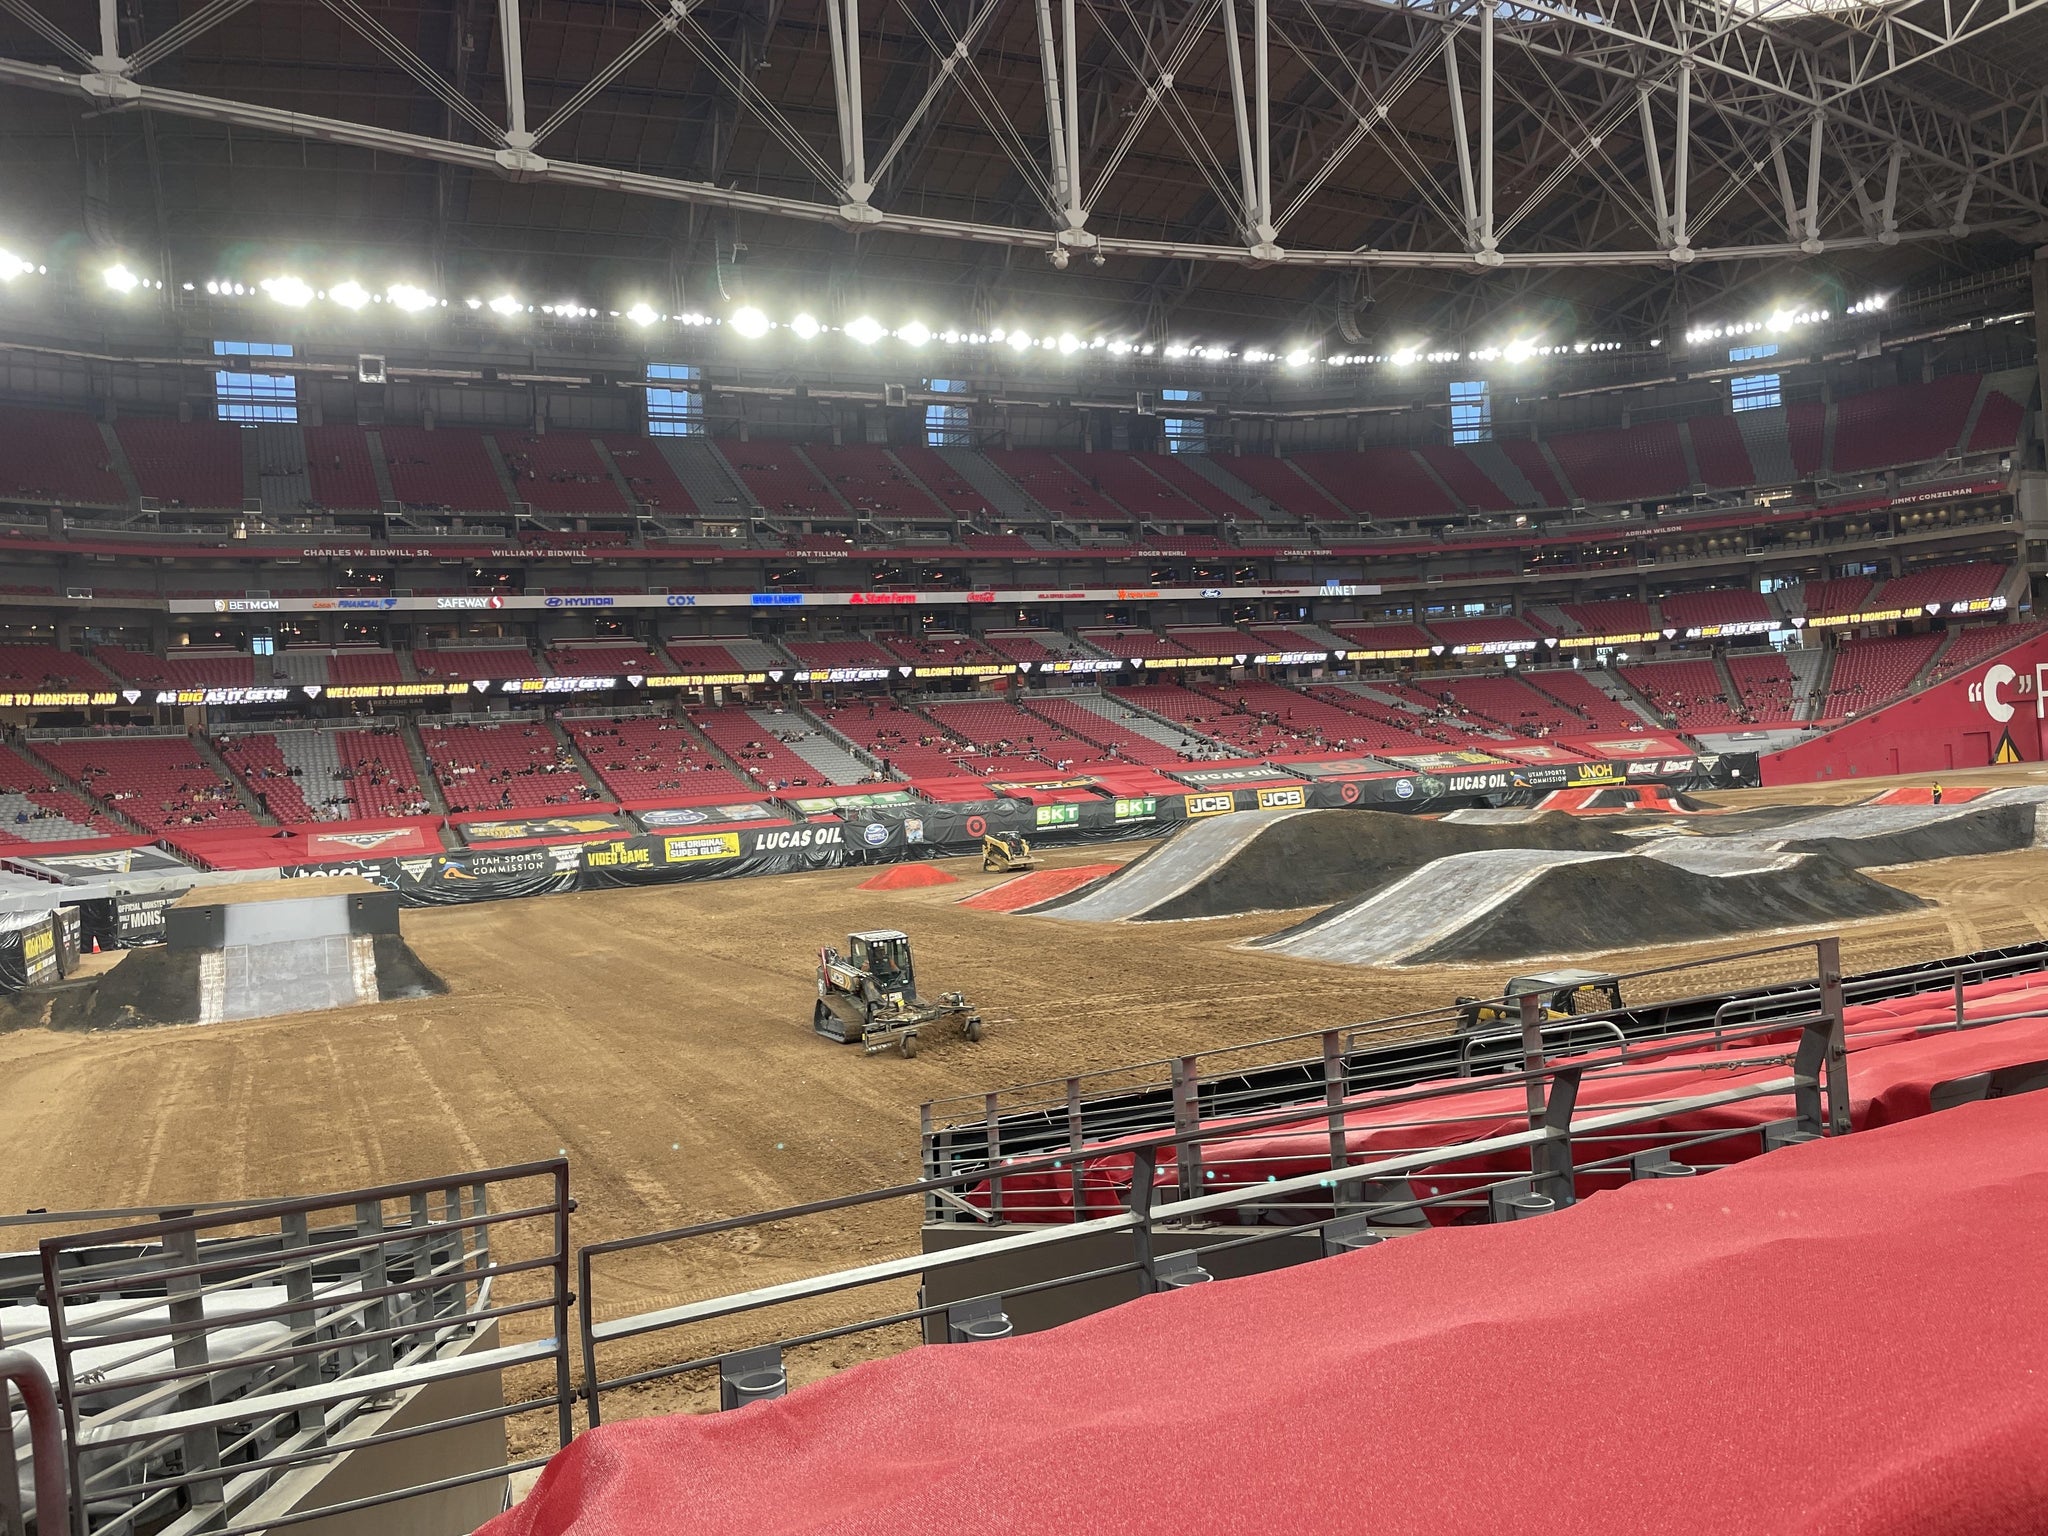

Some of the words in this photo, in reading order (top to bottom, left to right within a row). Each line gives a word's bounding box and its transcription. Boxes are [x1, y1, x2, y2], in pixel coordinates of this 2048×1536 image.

[1890, 495, 1917, 506] JIMMY
[1919, 487, 1973, 501] CONZELMAN
[1625, 529, 1652, 537] ADRIAN
[1653, 525, 1682, 534] WILSON
[303, 549, 351, 557] CHARLES
[354, 549, 368, 557] W.
[370, 549, 414, 558] BIDWILL,
[417, 549, 433, 557] SR.
[1319, 585, 1357, 596] AVNET
[230, 600, 279, 610] BETMGM
[338, 600, 379, 608] FINANCIAL
[437, 597, 488, 608] SAFEWAY
[565, 597, 614, 606] HYUNDAI
[667, 595, 696, 605] COX
[866, 593, 890, 604] State
[891, 593, 916, 604] Farm
[1951, 603, 1968, 613] AS
[1969, 600, 1989, 610] BIG
[1989, 597, 2006, 607] AS
[1808, 616, 1849, 627] WELCOME
[1850, 615, 1860, 624] TO
[1861, 611, 1902, 623] MONSTER
[1903, 608, 1923, 618] JAM
[1686, 628, 1701, 637] AS
[1702, 627, 1720, 636] BIG
[1720, 626, 1735, 635] AS
[1735, 625, 1747, 633] IT
[1559, 638, 1594, 648] WELCOME
[1594, 637, 1604, 646] TO
[1605, 635, 1640, 645] MONSTER
[1641, 632, 1660, 642] JAM
[1347, 651, 1376, 660] WELCOME
[1376, 650, 1384, 659] TO
[1385, 649, 1413, 659] MONSTER
[1414, 648, 1430, 657] JAM
[1452, 646, 1466, 654] AS
[1467, 645, 1482, 653] BIG
[1483, 644, 1496, 652] AS
[1496, 643, 1506, 652] IT
[1145, 660, 1177, 668] WELCOME
[1178, 659, 1186, 667] TO
[1186, 658, 1219, 667] MONSTER
[1219, 657, 1234, 665] JAM
[1254, 655, 1267, 663] AS
[1267, 654, 1281, 662] BIG
[1281, 654, 1294, 662] AS
[1294, 653, 1303, 661] IT
[915, 667, 952, 677] WELCOME
[953, 667, 963, 676] TO
[963, 666, 999, 675] MONSTER
[999, 664, 1017, 674] JAM
[1040, 663, 1054, 672] AS
[1054, 662, 1071, 671] BIG
[1071, 662, 1084, 671] AS
[1084, 661, 1096, 670] IT
[646, 676, 690, 687] WELCOME
[691, 675, 702, 685] TO
[704, 674, 745, 684] MONSTER
[746, 673, 765, 683] JAM
[794, 672, 810, 681] AS
[810, 671, 829, 680] BIG
[830, 671, 845, 680] AS
[845, 670, 857, 679] IT
[326, 686, 379, 698] WELCOME
[381, 685, 394, 697] TO
[396, 684, 445, 696] MONSTER
[445, 683, 469, 695] JAM
[502, 681, 521, 692] AS
[522, 680, 544, 690] BIG
[545, 680, 562, 689] AS
[562, 679, 576, 689] IT
[14, 694, 31, 706] TO
[33, 693, 89, 705] MONSTER
[91, 693, 118, 704] JAM
[156, 692, 177, 703] AS
[178, 691, 204, 703] BIG
[205, 691, 227, 702] AS
[228, 690, 243, 702] IT
[1183, 770, 1245, 782] LUCAS
[1247, 768, 1281, 777] OIL
[1545, 769, 1566, 777] SPORTS
[1578, 763, 1613, 778] UNOH
[1449, 775, 1486, 791] LUCAS
[1529, 775, 1567, 785] COMMISSION
[1190, 796, 1230, 813] JCB
[1263, 790, 1301, 806] JCB
[1038, 806, 1079, 822] BKT
[1116, 801, 1156, 817] BKT
[669, 840, 686, 849] THE
[686, 837, 726, 848] ORIGINAL
[755, 830, 812, 850] LUCAS
[609, 841, 626, 854] THE
[670, 848, 698, 858] SUPER
[700, 847, 722, 856] GLUE
[472, 856, 500, 866] UTAH
[505, 852, 544, 863] SPORTS
[587, 851, 620, 867] VIDEO
[620, 848, 650, 863] GAME
[473, 861, 544, 876] COMMISSION
[118, 902, 142, 913] OFFICIAL
